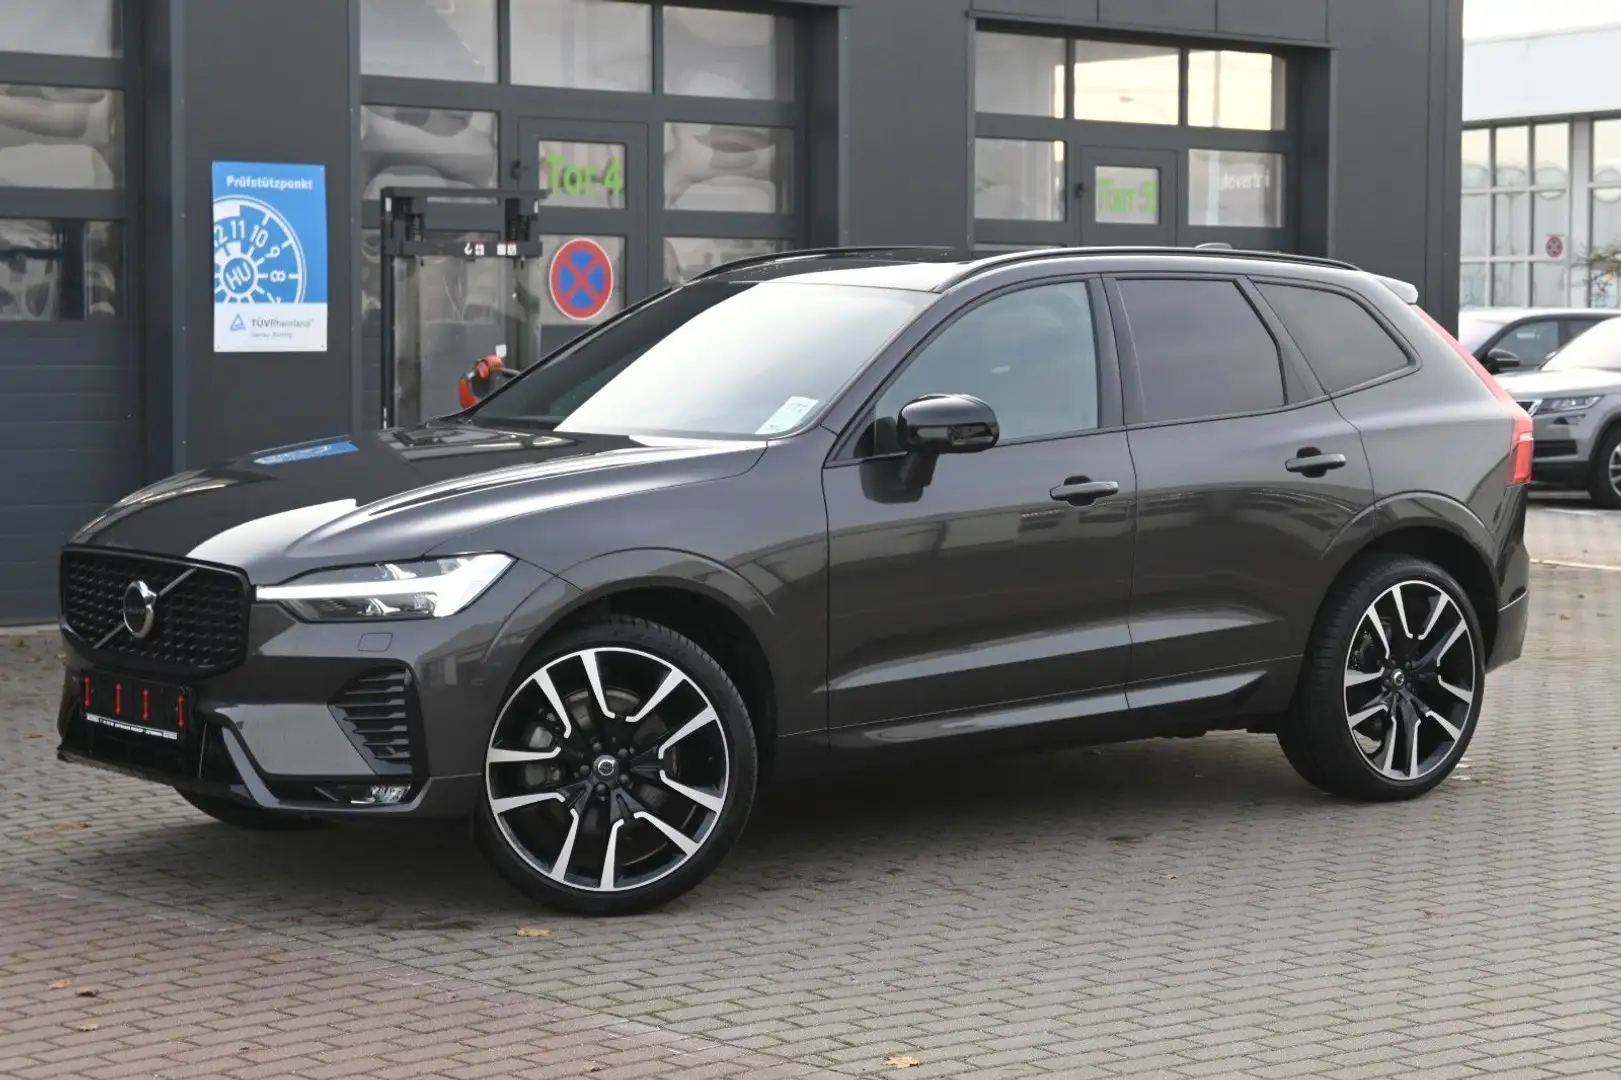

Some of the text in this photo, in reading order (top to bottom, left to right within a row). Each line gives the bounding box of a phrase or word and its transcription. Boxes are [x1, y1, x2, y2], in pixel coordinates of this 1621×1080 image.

[226, 175, 313, 191] Prüfstützpunkt
[546, 154, 623, 196] Tor 4
[230, 219, 245, 240] 11
[249, 223, 269, 248] 10
[224, 260, 252, 291] HU
[269, 270, 287, 283] 8
